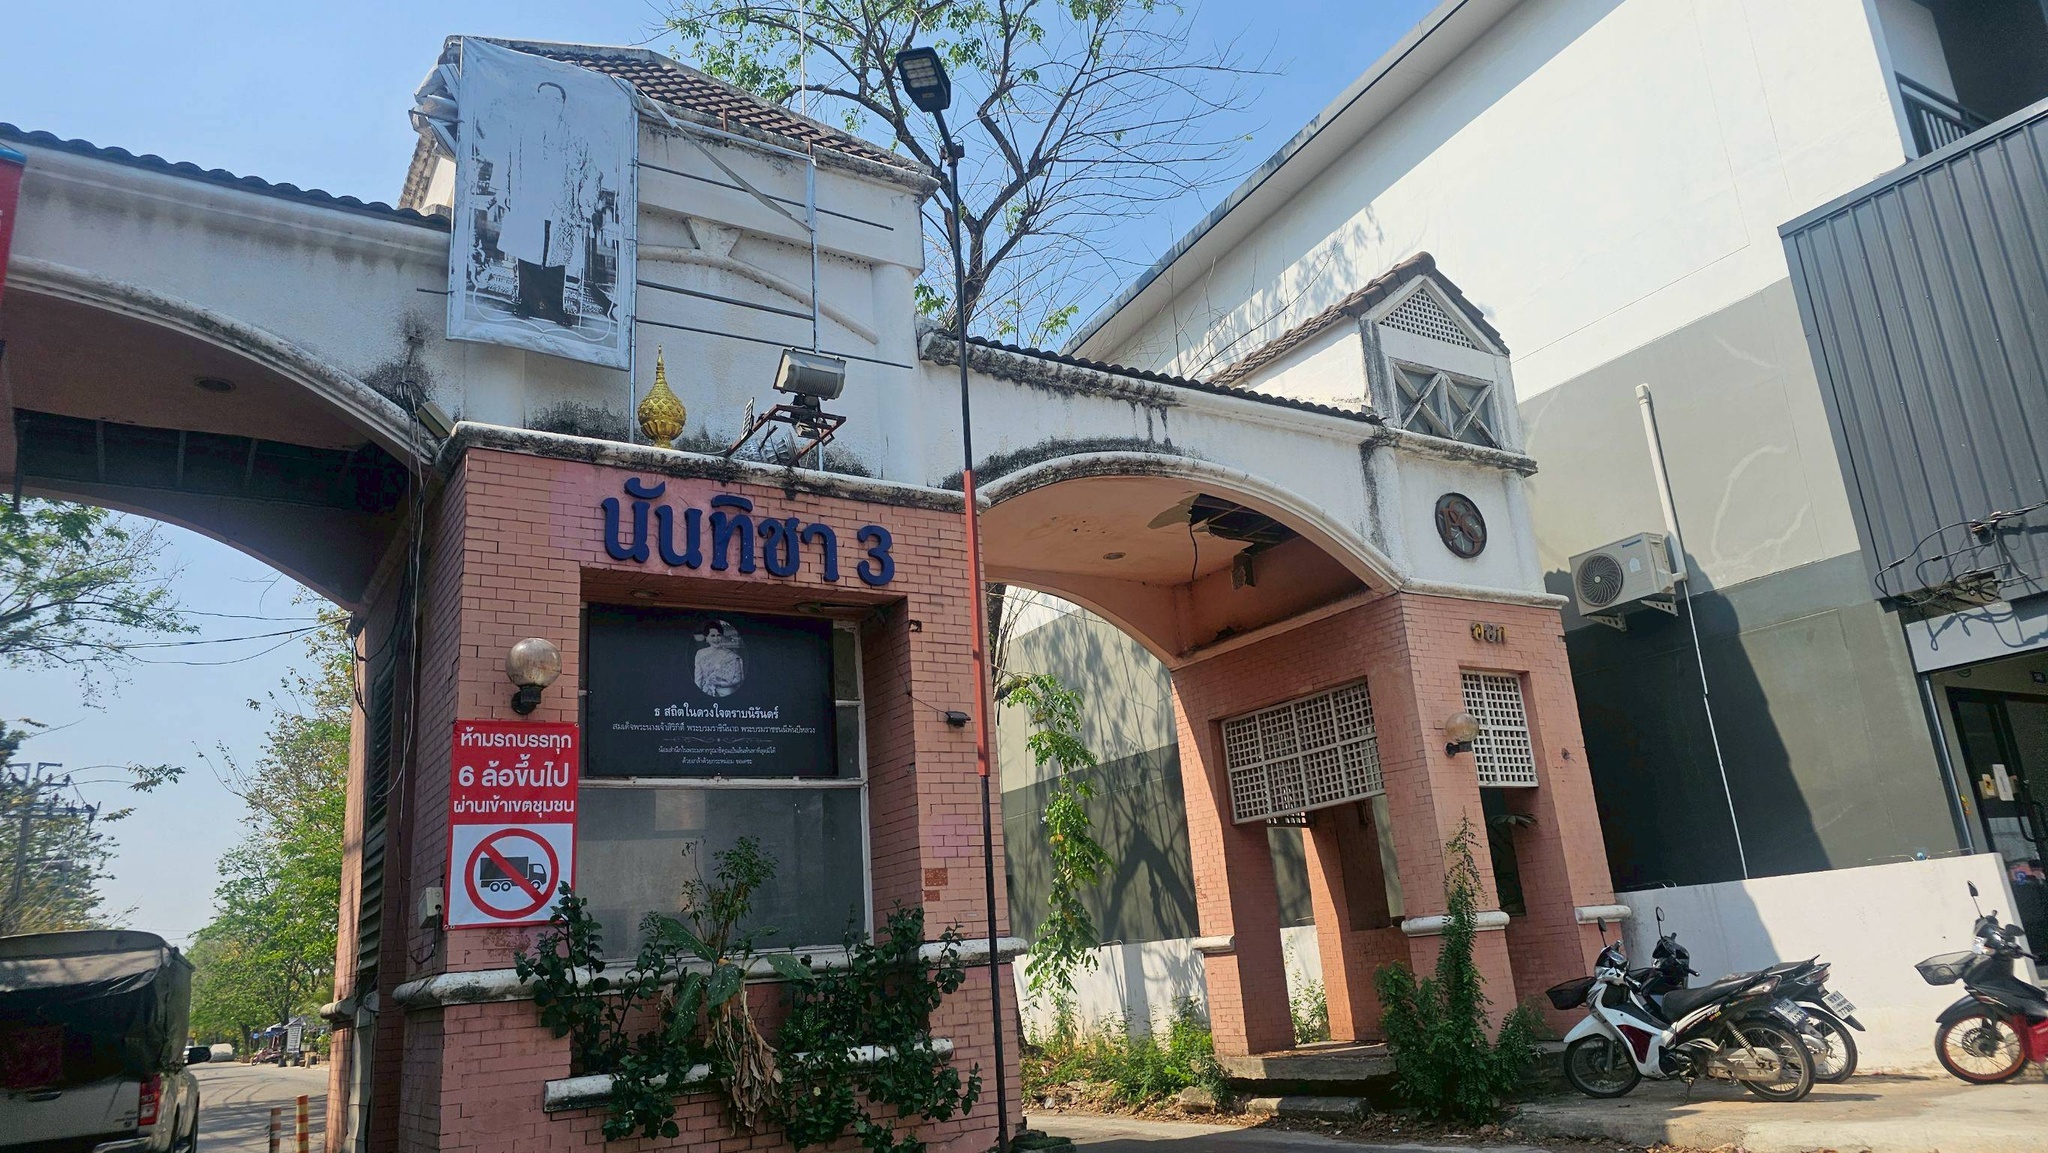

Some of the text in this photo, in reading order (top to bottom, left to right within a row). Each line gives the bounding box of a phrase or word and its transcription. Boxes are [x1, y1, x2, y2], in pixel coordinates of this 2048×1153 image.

[601, 477, 896, 587] นันทิชา 3
[653, 702, 779, 719] ธ สถิตในดวงใจตราบนิรันดร์
[460, 726, 572, 755] ห้ามรถบรรทุก
[458, 754, 570, 788] 6 ล้อขึ้นไป
[453, 795, 575, 819] ผ่านเข้าเขตชุมชน
